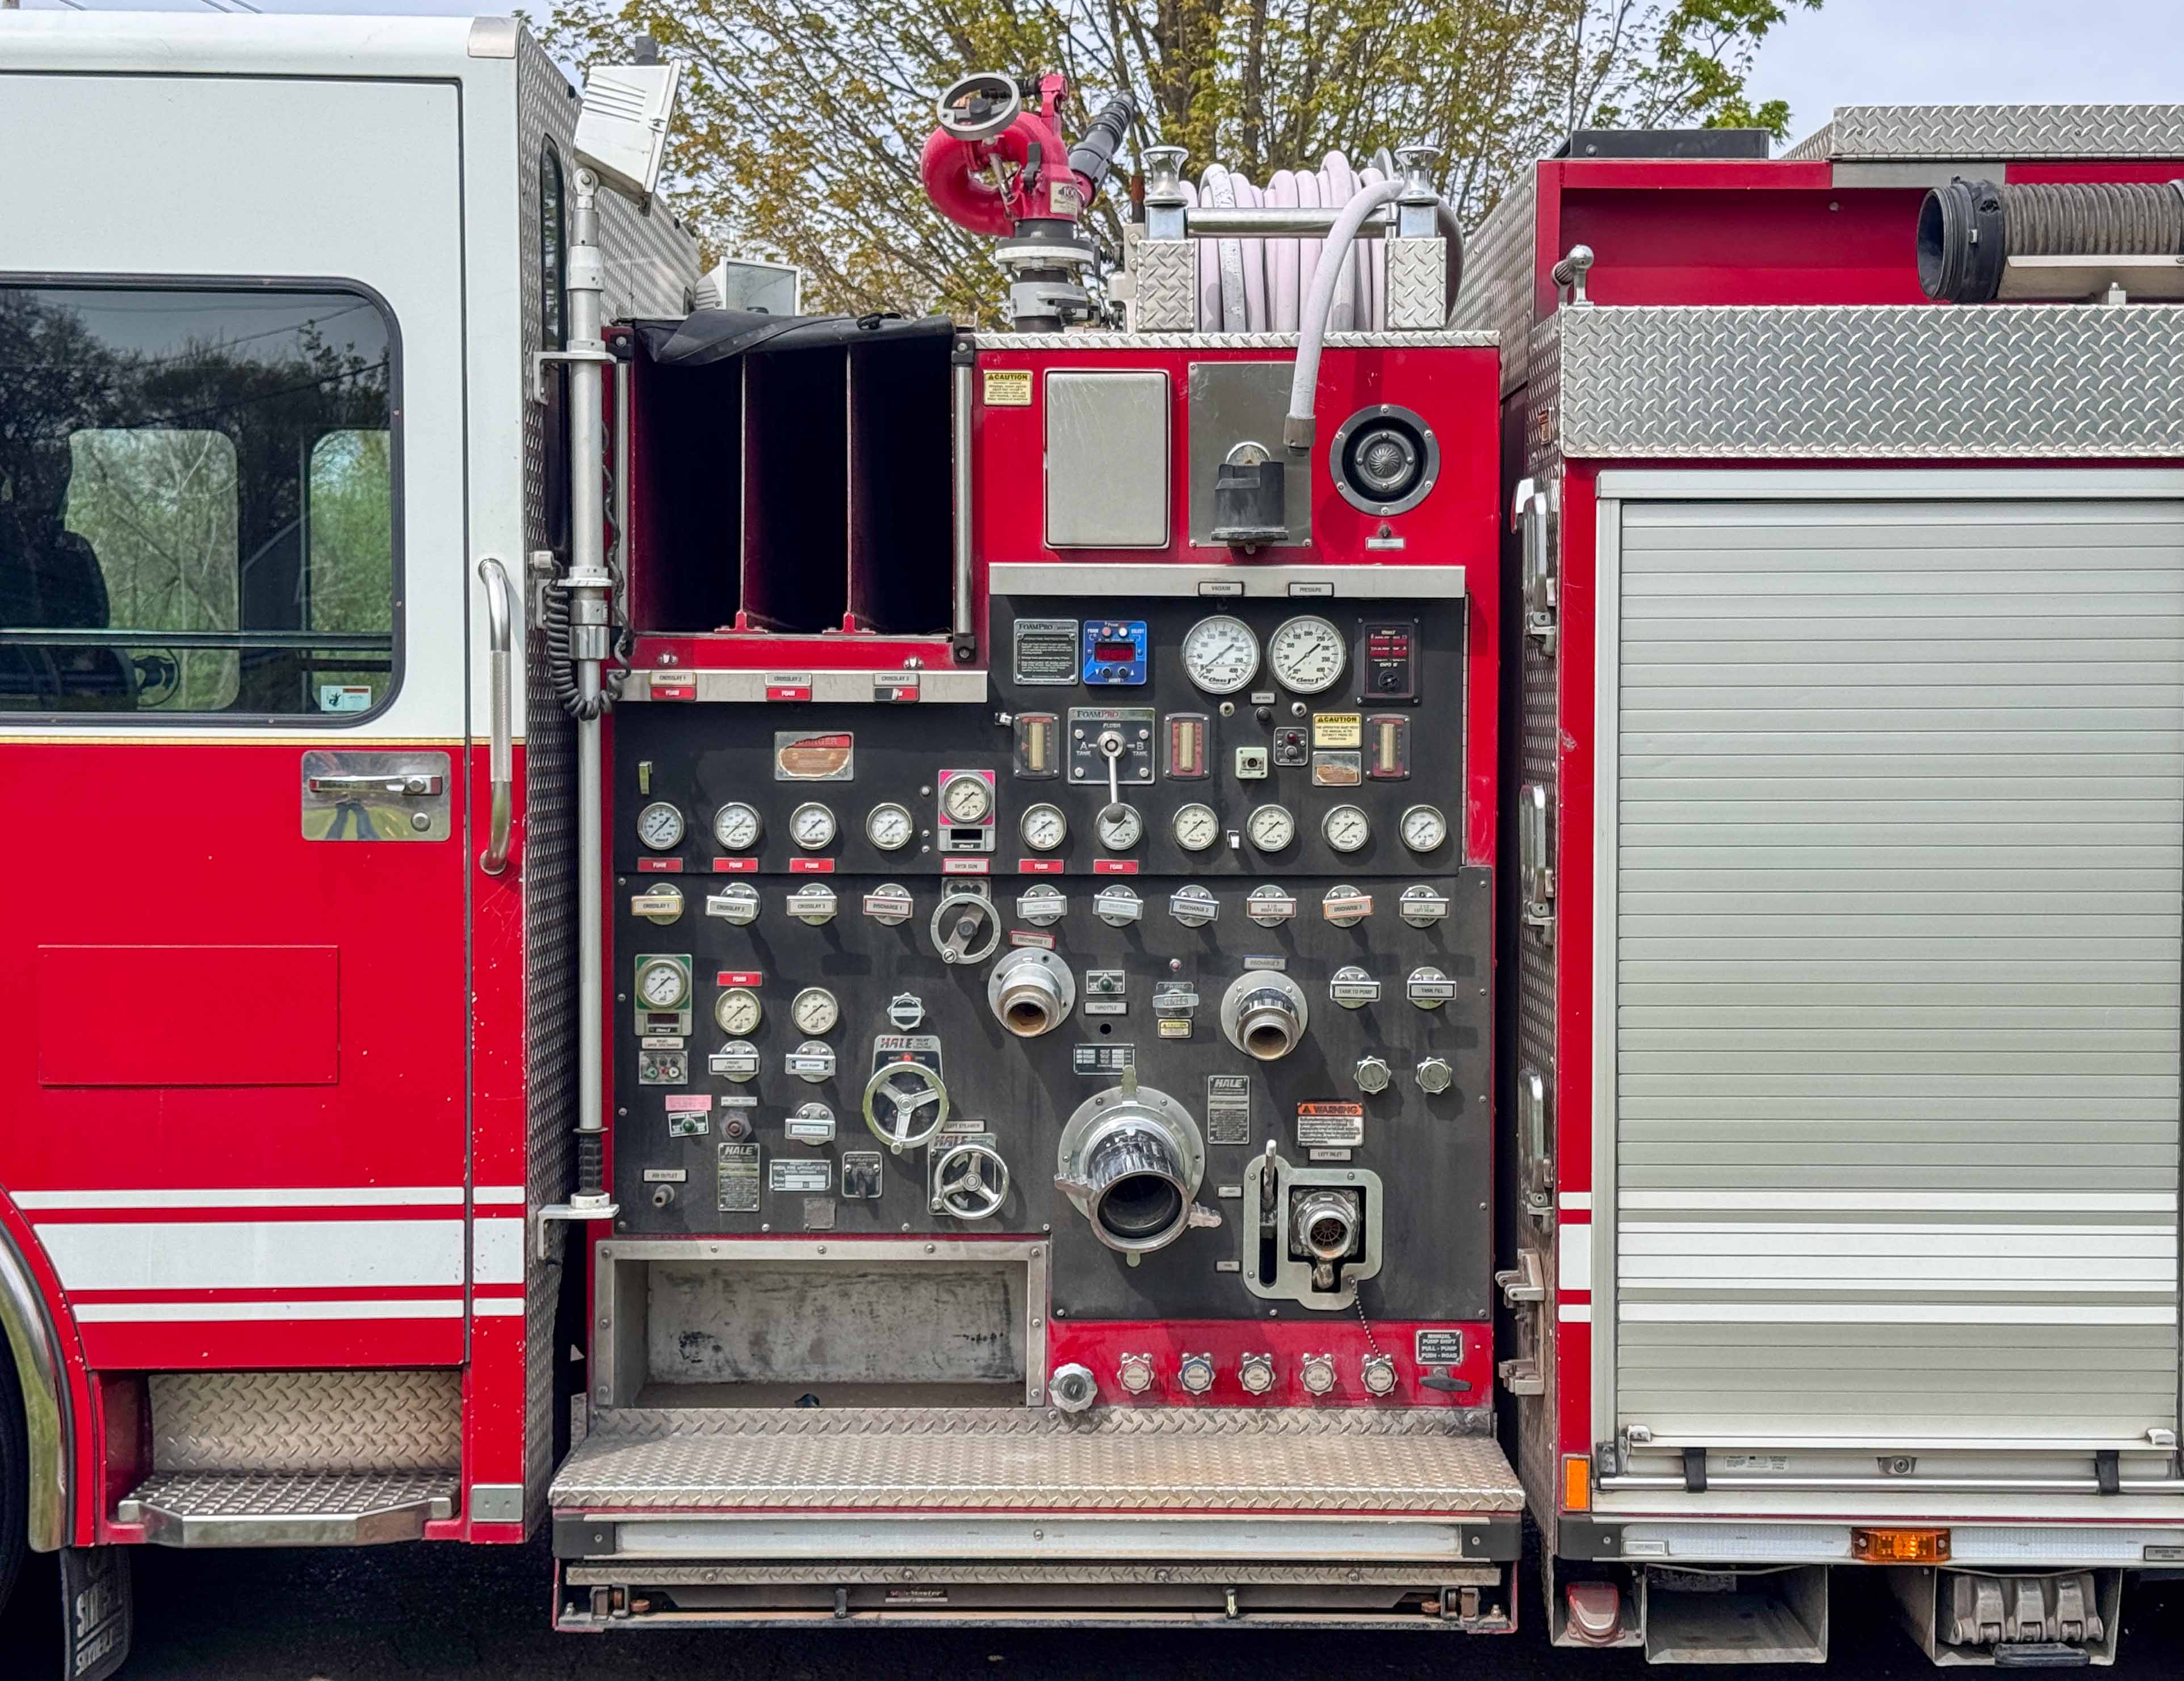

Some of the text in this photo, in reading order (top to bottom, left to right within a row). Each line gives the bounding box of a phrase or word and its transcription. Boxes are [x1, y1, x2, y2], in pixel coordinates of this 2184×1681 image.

[1080, 741, 1088, 750] A
[1137, 741, 1145, 750] B
[880, 1038, 913, 1049] HALE
[1214, 1079, 1243, 1088] HALE
[724, 1146, 753, 1155] HALE
